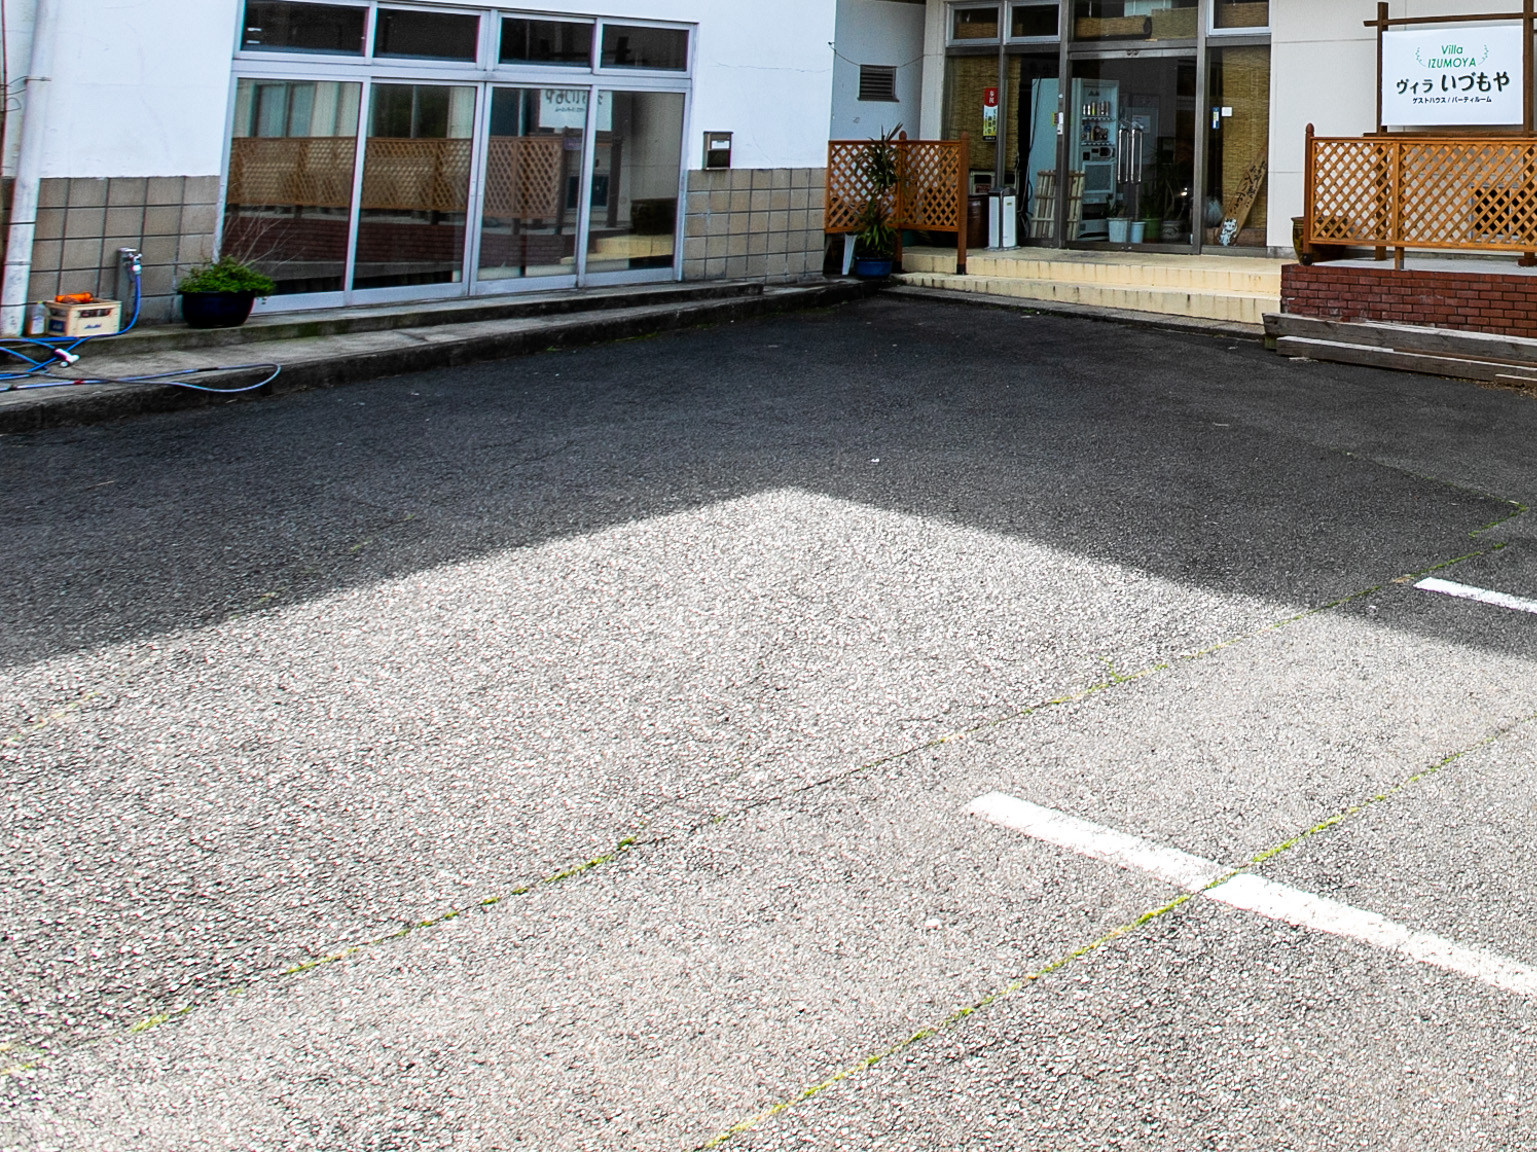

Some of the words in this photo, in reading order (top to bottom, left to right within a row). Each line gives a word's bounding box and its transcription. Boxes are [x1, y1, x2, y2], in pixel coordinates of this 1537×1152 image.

[1441, 44, 1463, 55] Villa
[1427, 57, 1476, 69] IZUMOYA
[1396, 78, 1433, 95] ヴィラ
[1441, 71, 1510, 92] いづもや
